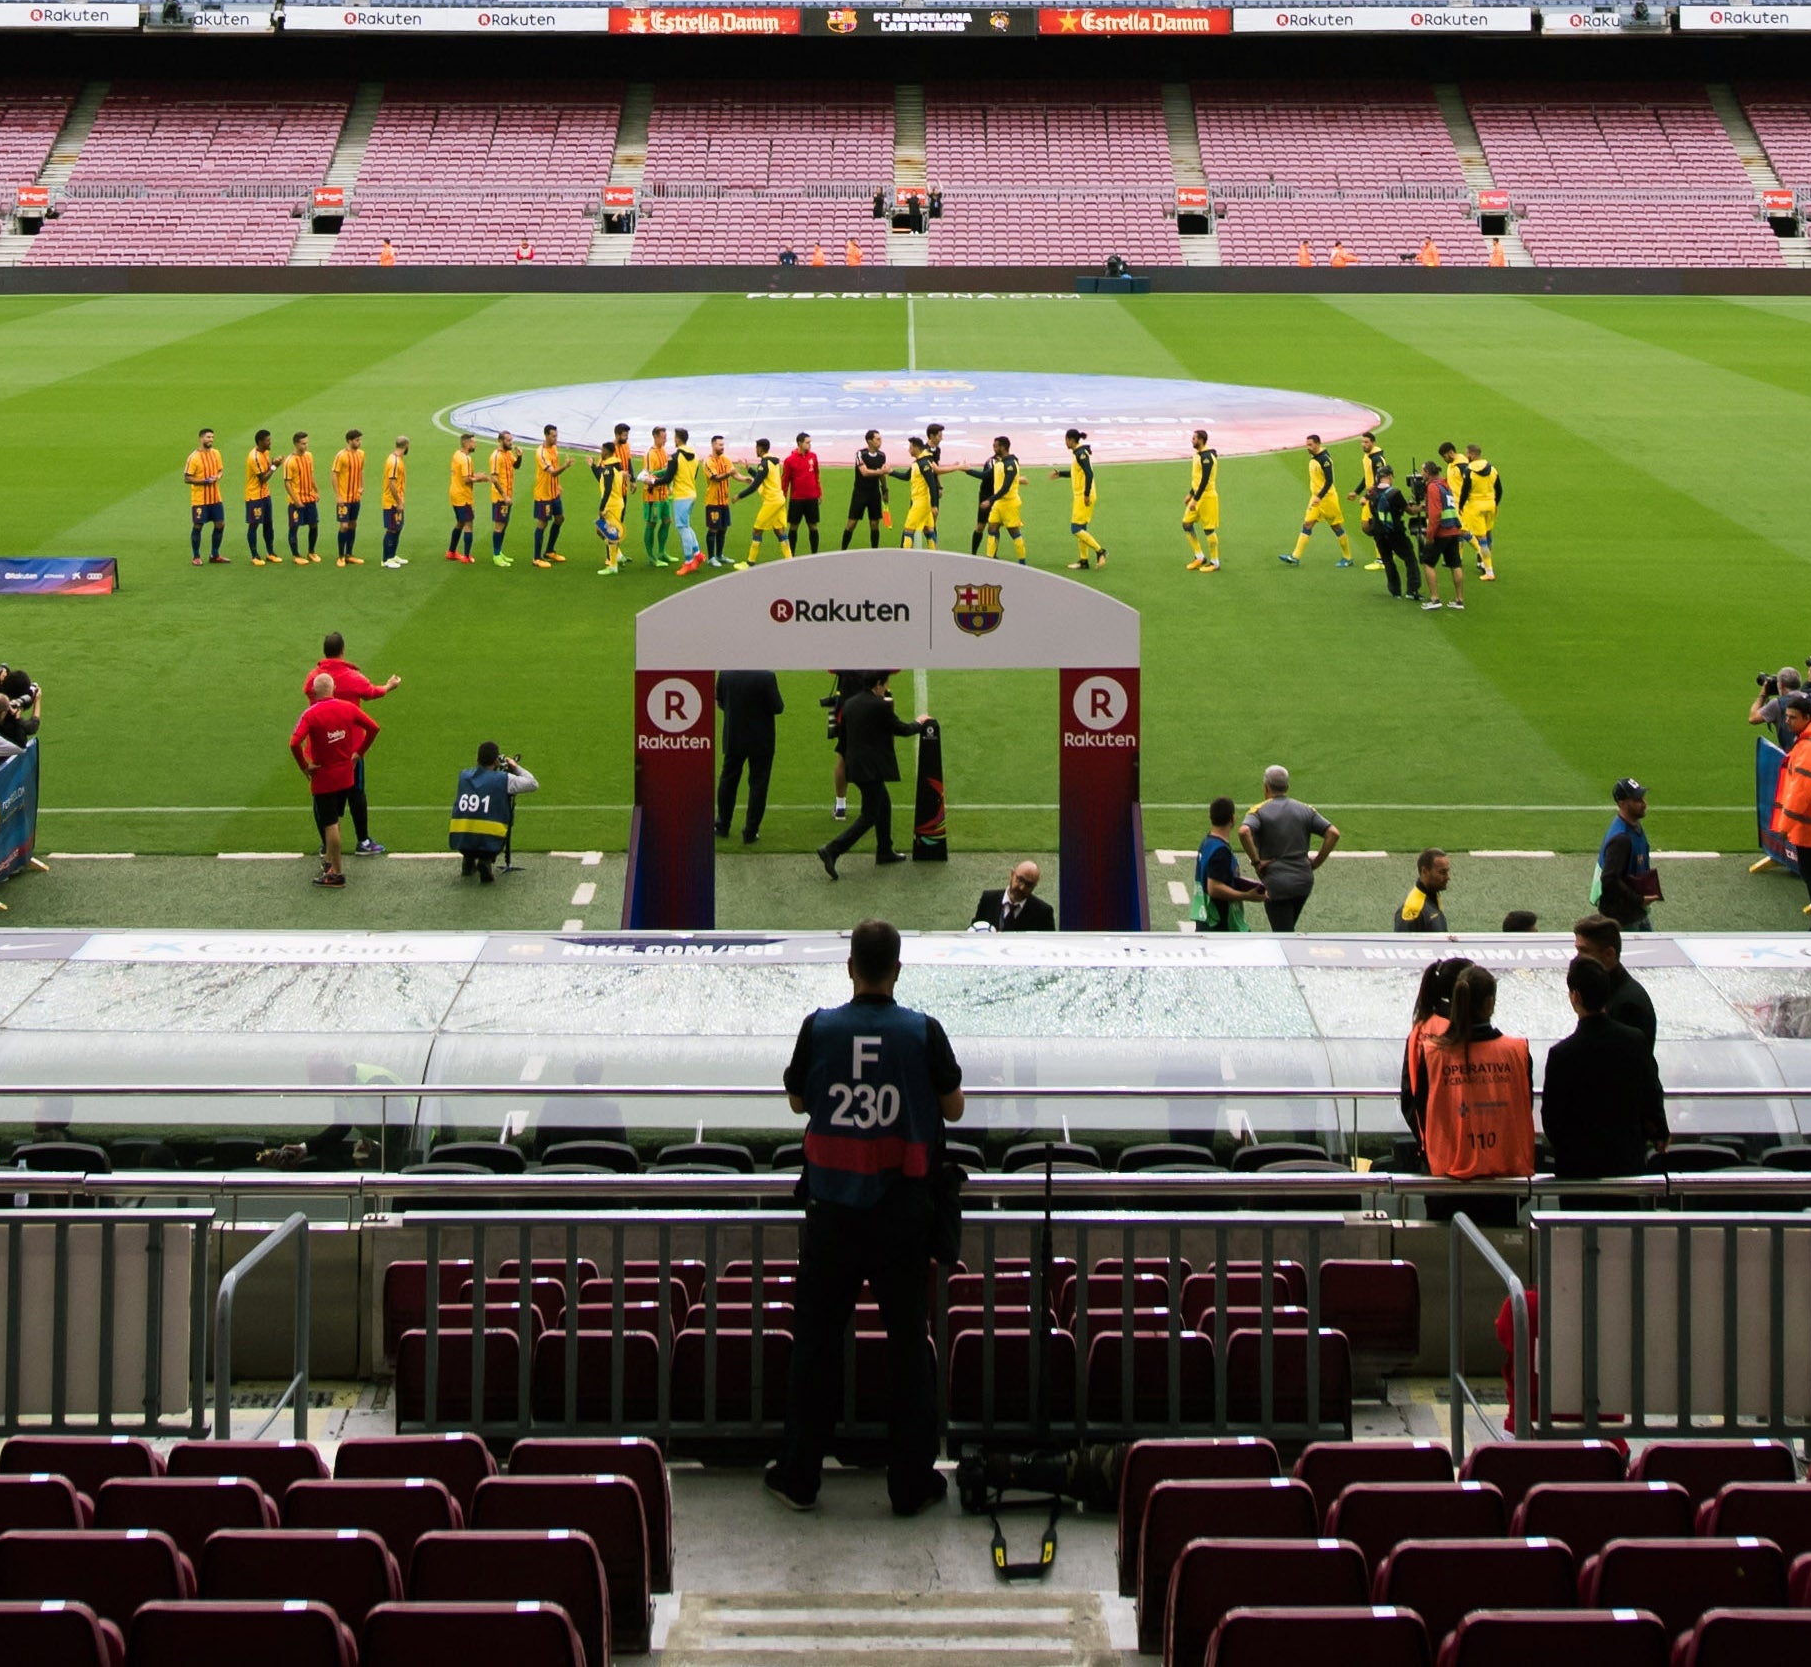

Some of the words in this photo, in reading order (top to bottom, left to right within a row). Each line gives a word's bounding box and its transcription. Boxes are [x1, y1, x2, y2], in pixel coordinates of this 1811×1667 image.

[44, 8, 109, 22] Rakuten
[193, 12, 250, 26] akuten
[357, 12, 422, 26] Rakuten
[491, 13, 556, 27] Rakuten
[650, 11, 720, 33] Estrella
[722, 12, 779, 33] Damm
[873, 13, 890, 22] FC
[892, 13, 972, 22] BARCELONA
[1081, 11, 1149, 32] Estrella
[1151, 12, 1209, 32] Damm
[1289, 13, 1354, 27] Rakuten
[1424, 12, 1488, 26] Rakuten
[1582, 13, 1621, 26] Raku
[1724, 10, 1789, 24] Rakuten
[881, 22, 907, 31] LAS
[909, 22, 965, 31] PALMAS
[795, 598, 910, 623] Rakuten
[664, 690, 687, 721] R
[1090, 688, 1113, 719] R
[638, 733, 711, 750] Rakuten
[1064, 731, 1136, 747] Rakuten
[458, 793, 491, 813] 691
[852, 1036, 882, 1079] F
[828, 1083, 900, 1129] 230
[1467, 1132, 1496, 1150] 110
